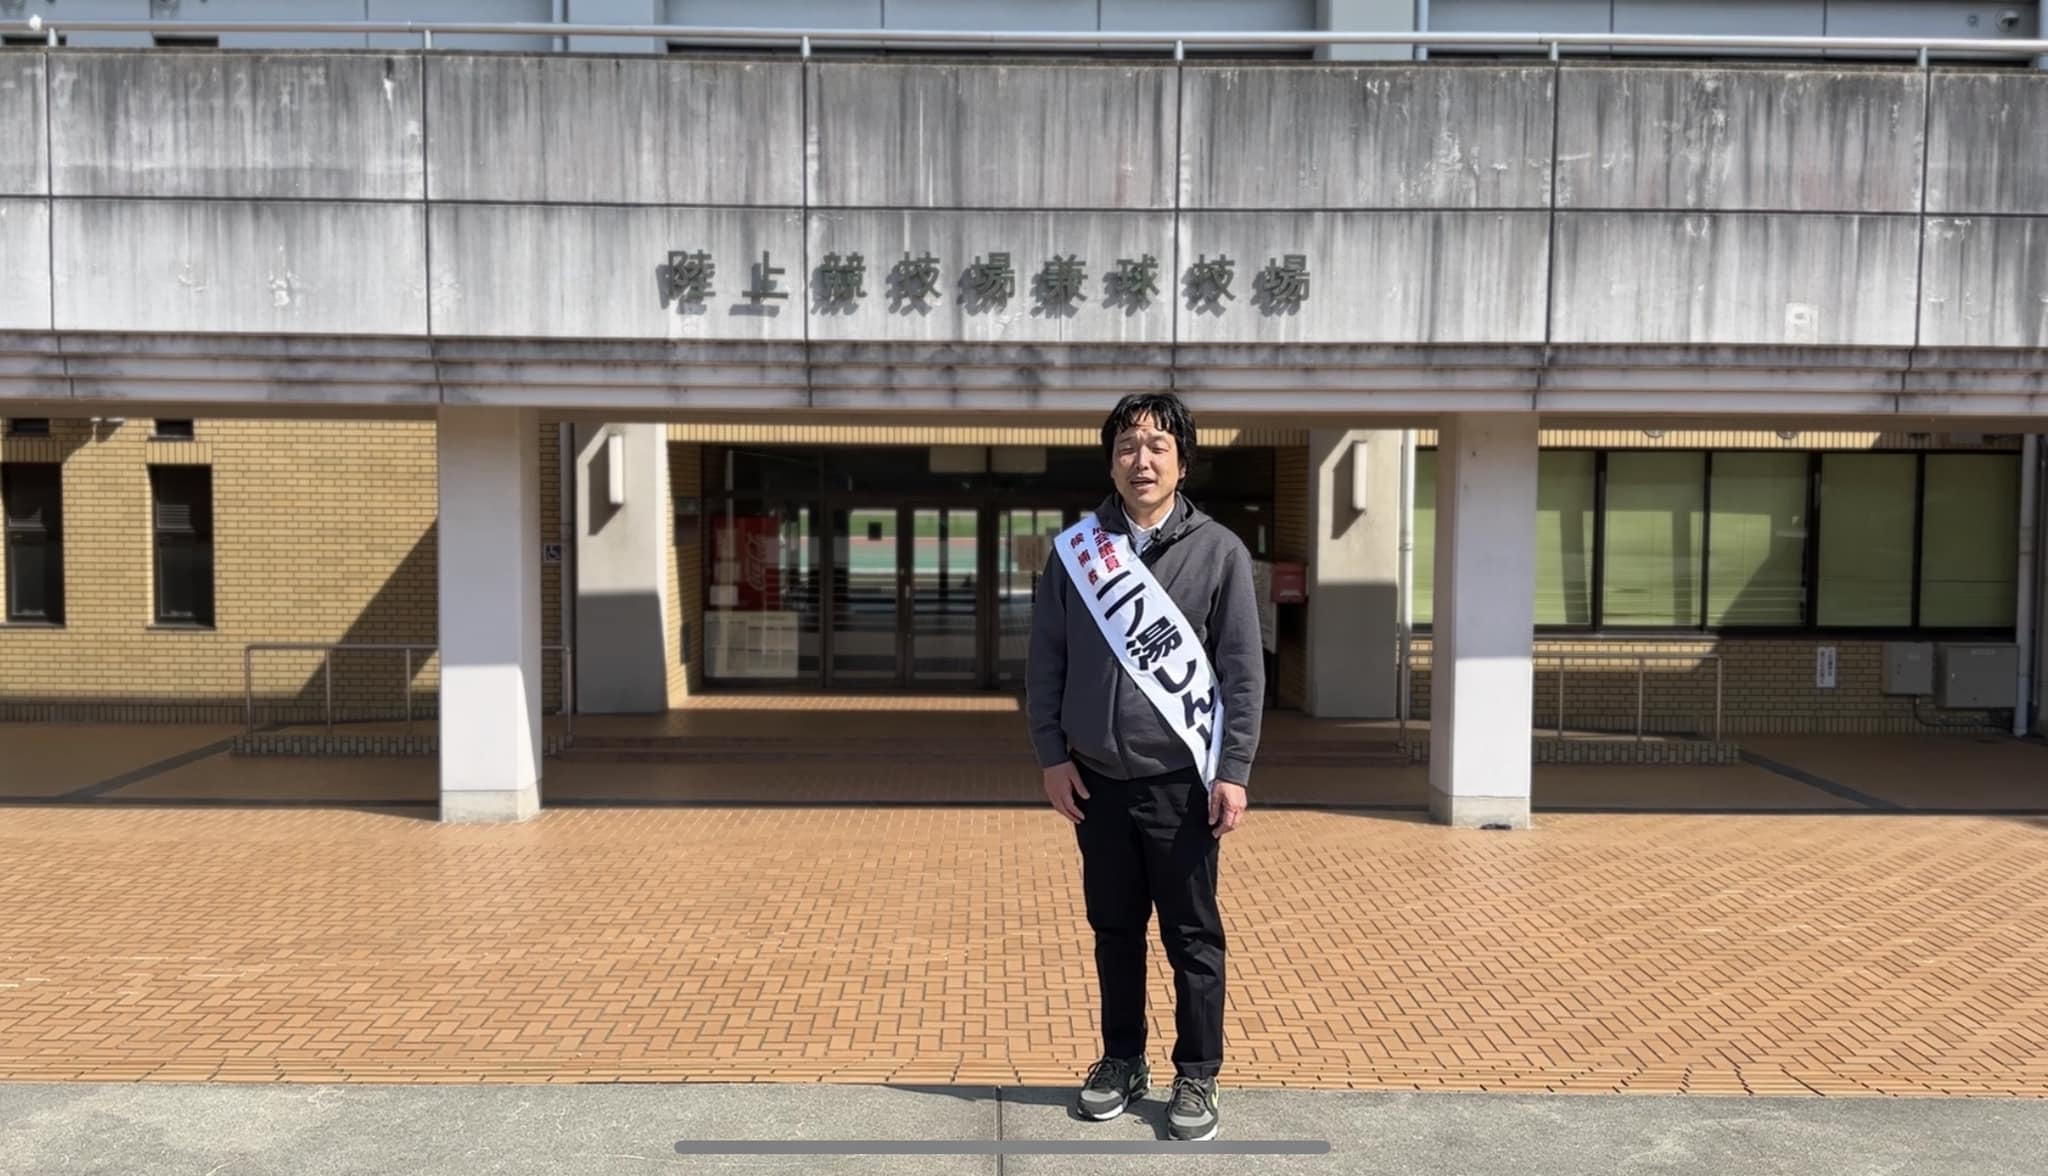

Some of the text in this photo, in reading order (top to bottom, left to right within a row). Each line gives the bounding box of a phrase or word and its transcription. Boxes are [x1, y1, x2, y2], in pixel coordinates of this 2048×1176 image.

[667, 249, 1310, 301] 陸上競技場兼球技場
